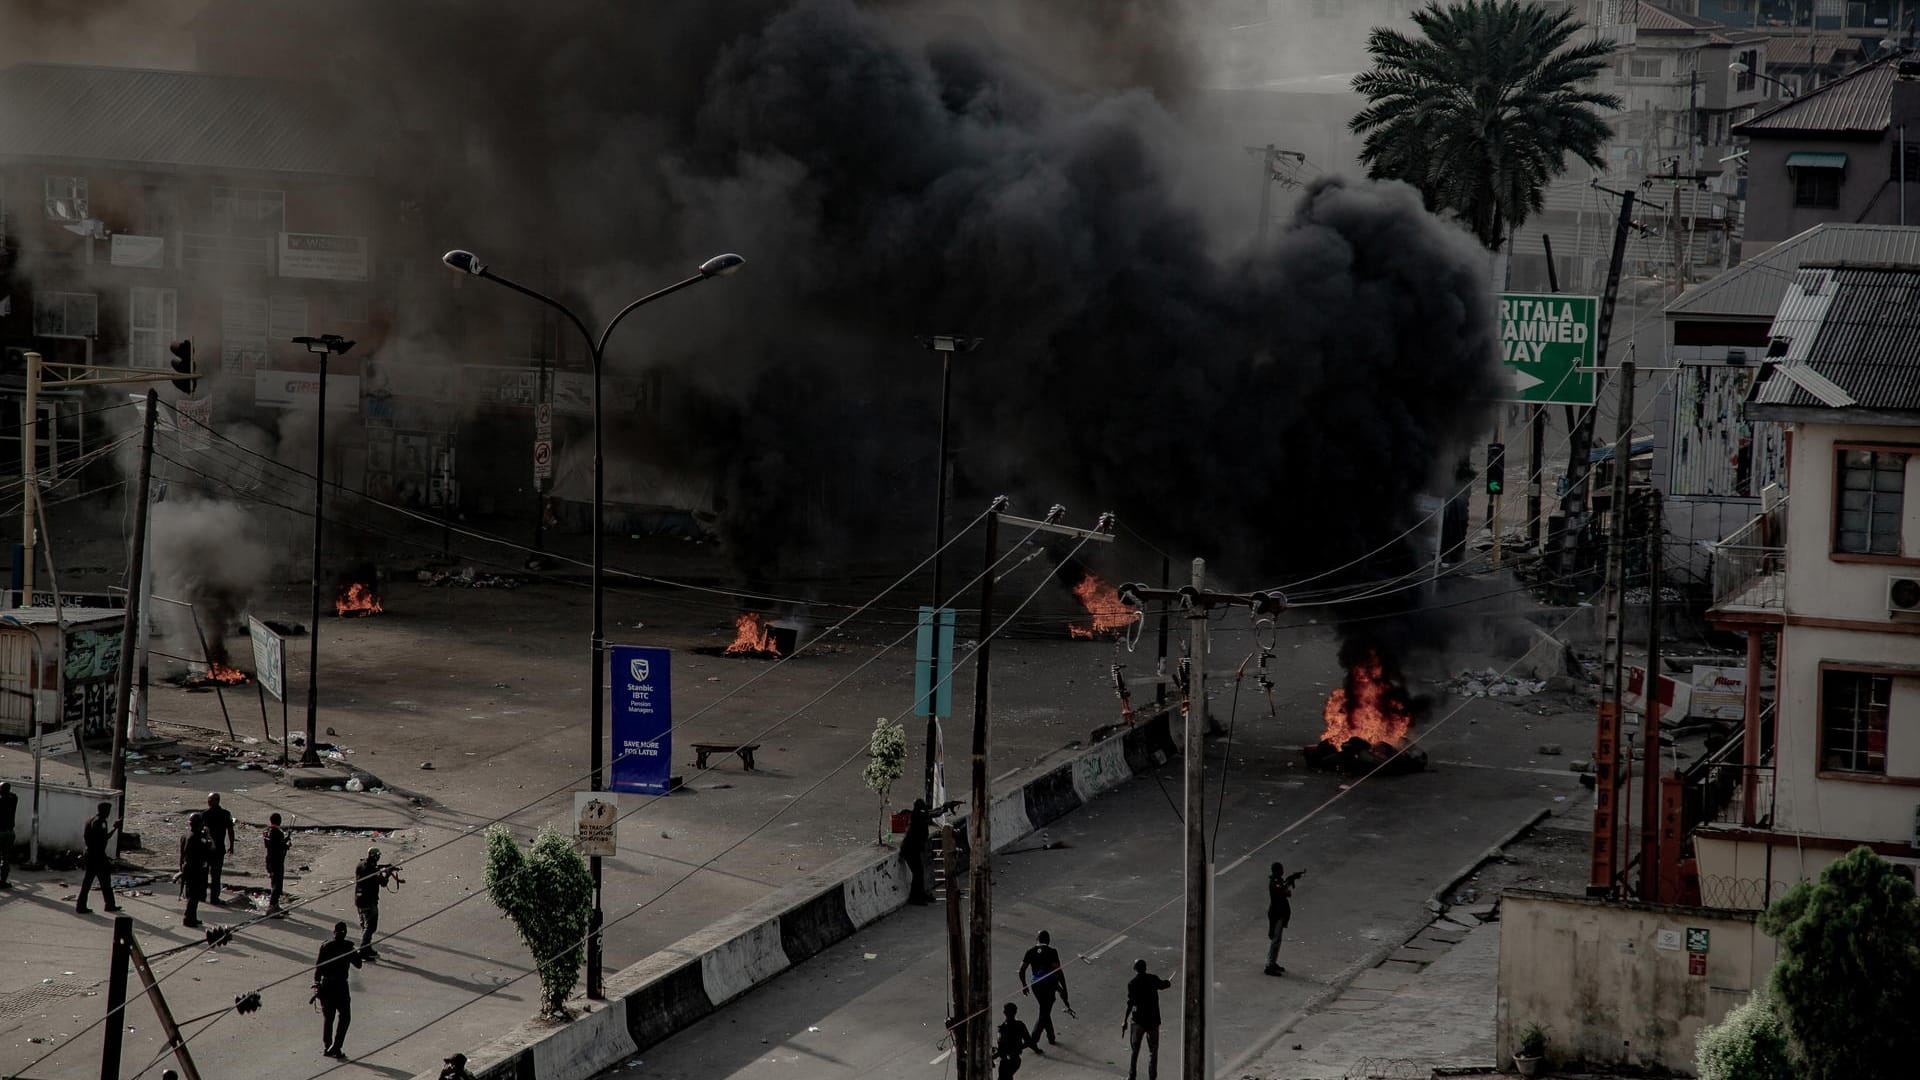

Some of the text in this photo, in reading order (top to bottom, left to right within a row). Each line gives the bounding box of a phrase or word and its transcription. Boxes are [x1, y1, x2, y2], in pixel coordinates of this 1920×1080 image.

[627, 683, 654, 692] Stanbic
[632, 692, 649, 700] IBTC
[628, 706, 654, 714] Managers
[638, 749, 658, 757] LATER
